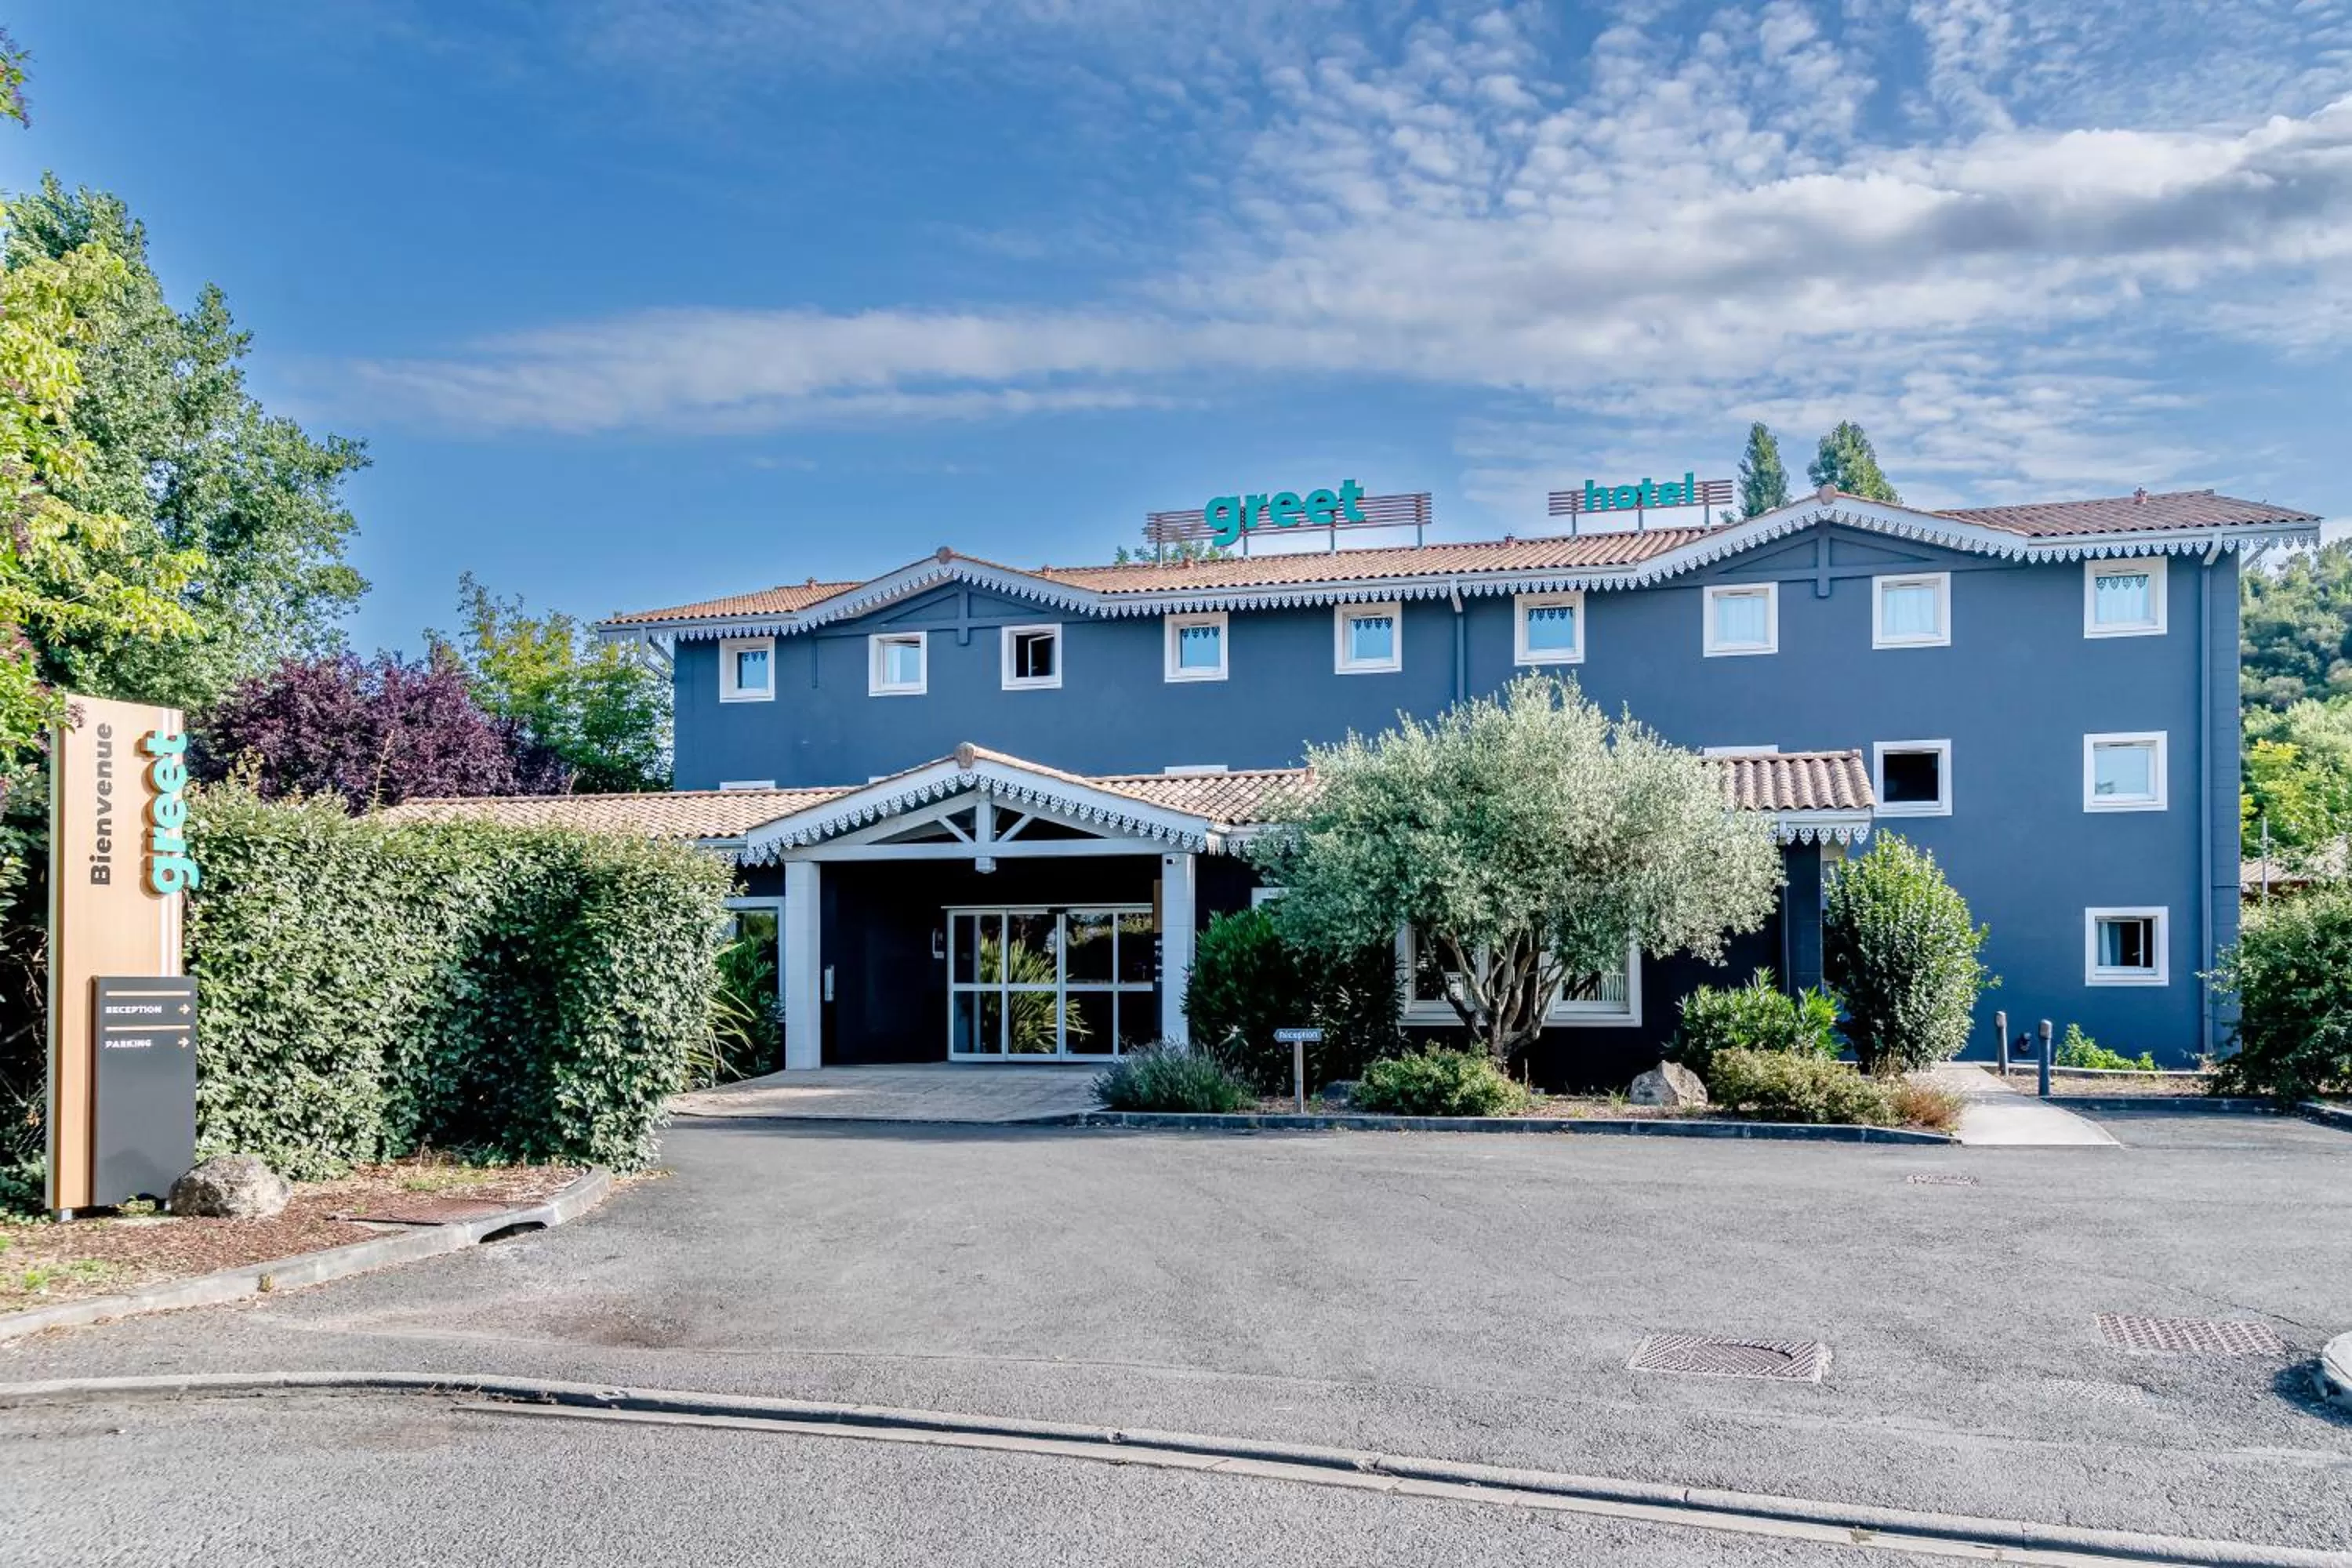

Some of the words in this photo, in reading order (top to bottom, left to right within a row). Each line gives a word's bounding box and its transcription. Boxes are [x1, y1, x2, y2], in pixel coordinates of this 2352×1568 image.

[1204, 479, 1367, 546] greet
[1584, 471, 1694, 510] hotel
[89, 722, 113, 885] Bienvenue
[144, 730, 200, 894] greet
[105, 1005, 162, 1014] RECEPTION
[105, 1039, 151, 1048] PARKING
